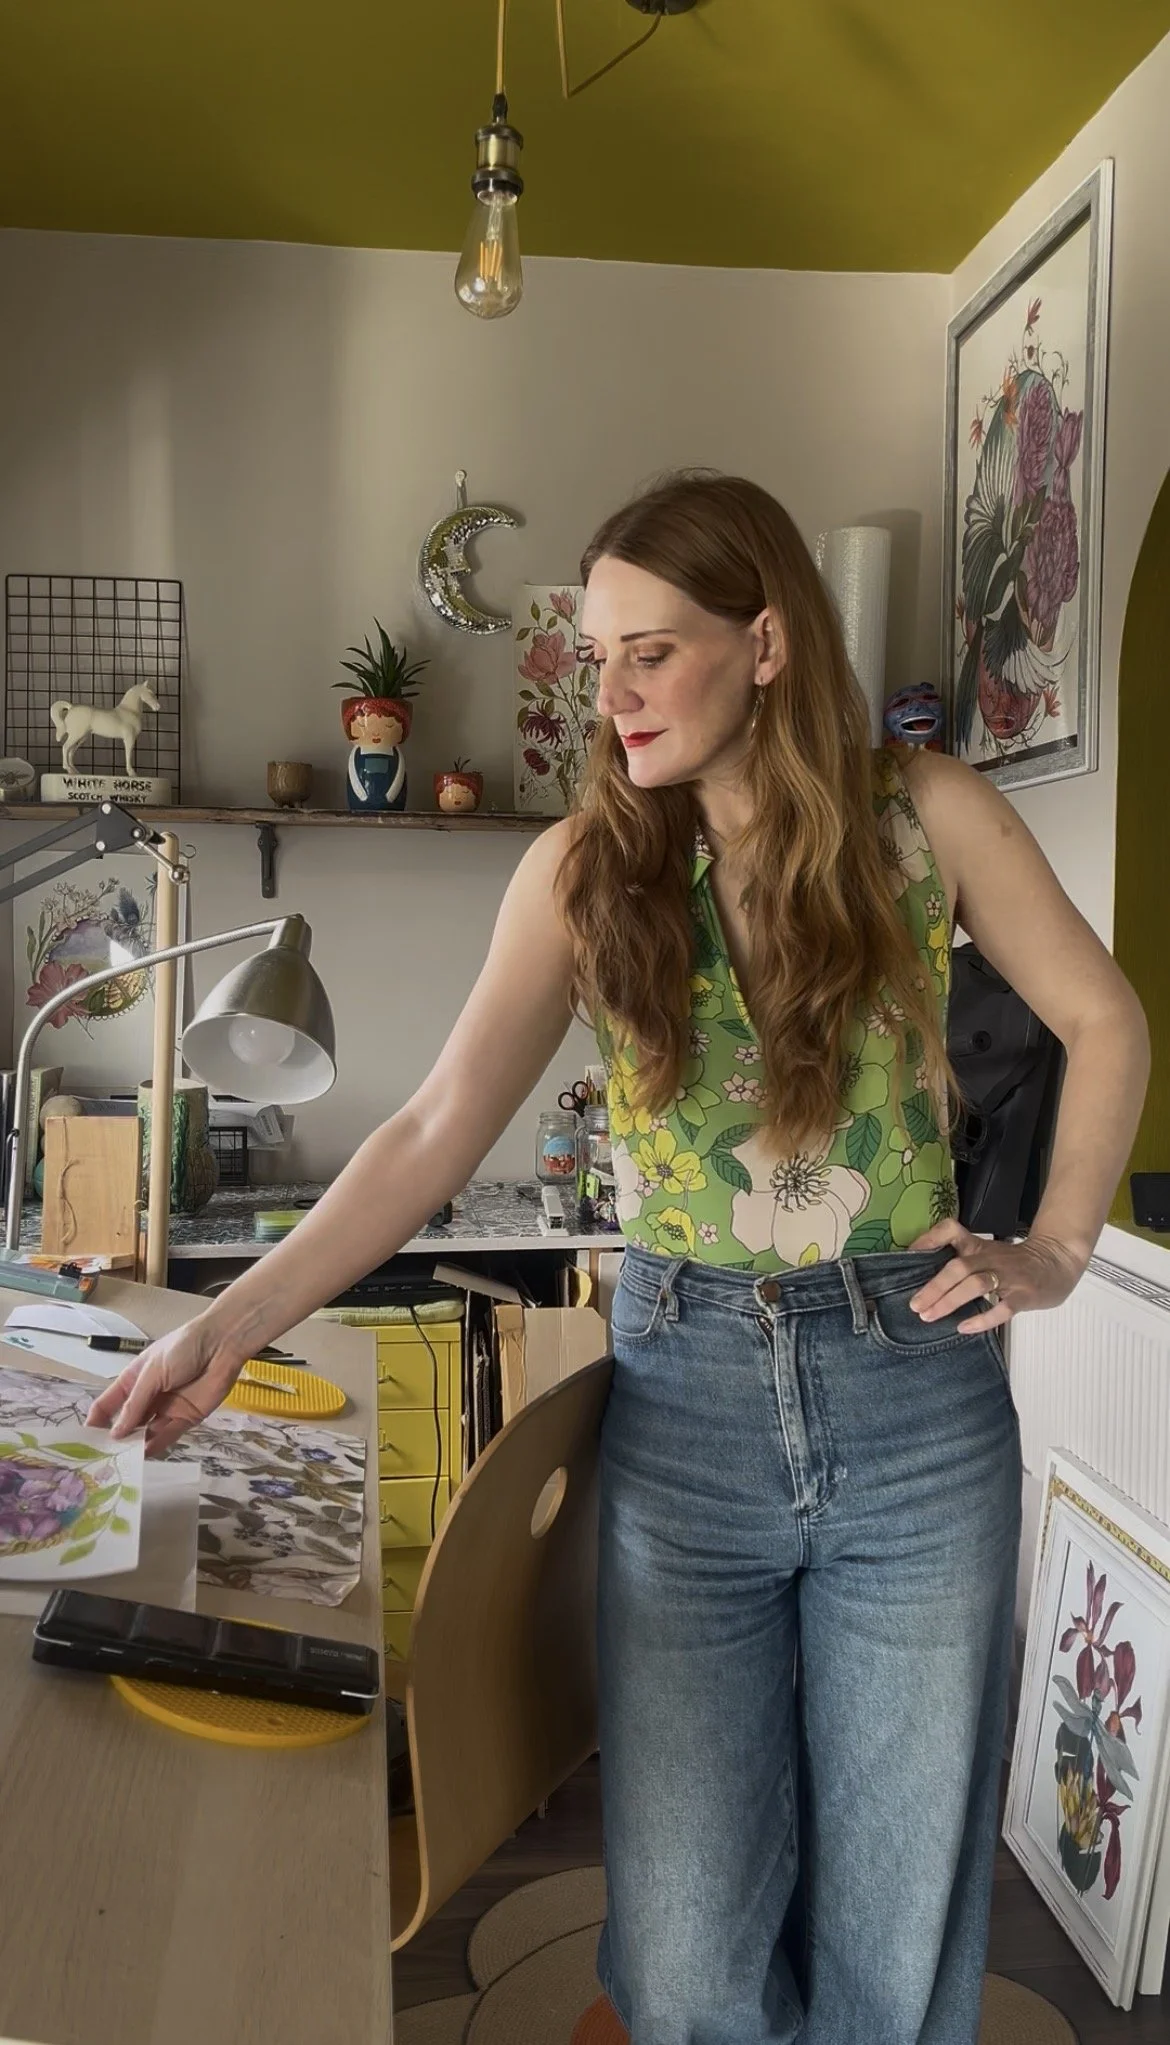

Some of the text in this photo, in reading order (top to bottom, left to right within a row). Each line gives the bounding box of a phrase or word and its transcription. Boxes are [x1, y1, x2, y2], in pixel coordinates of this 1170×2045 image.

[63, 777, 152, 792] WHITE HORSE
[67, 792, 147, 804] SCOTCH WHISKY
